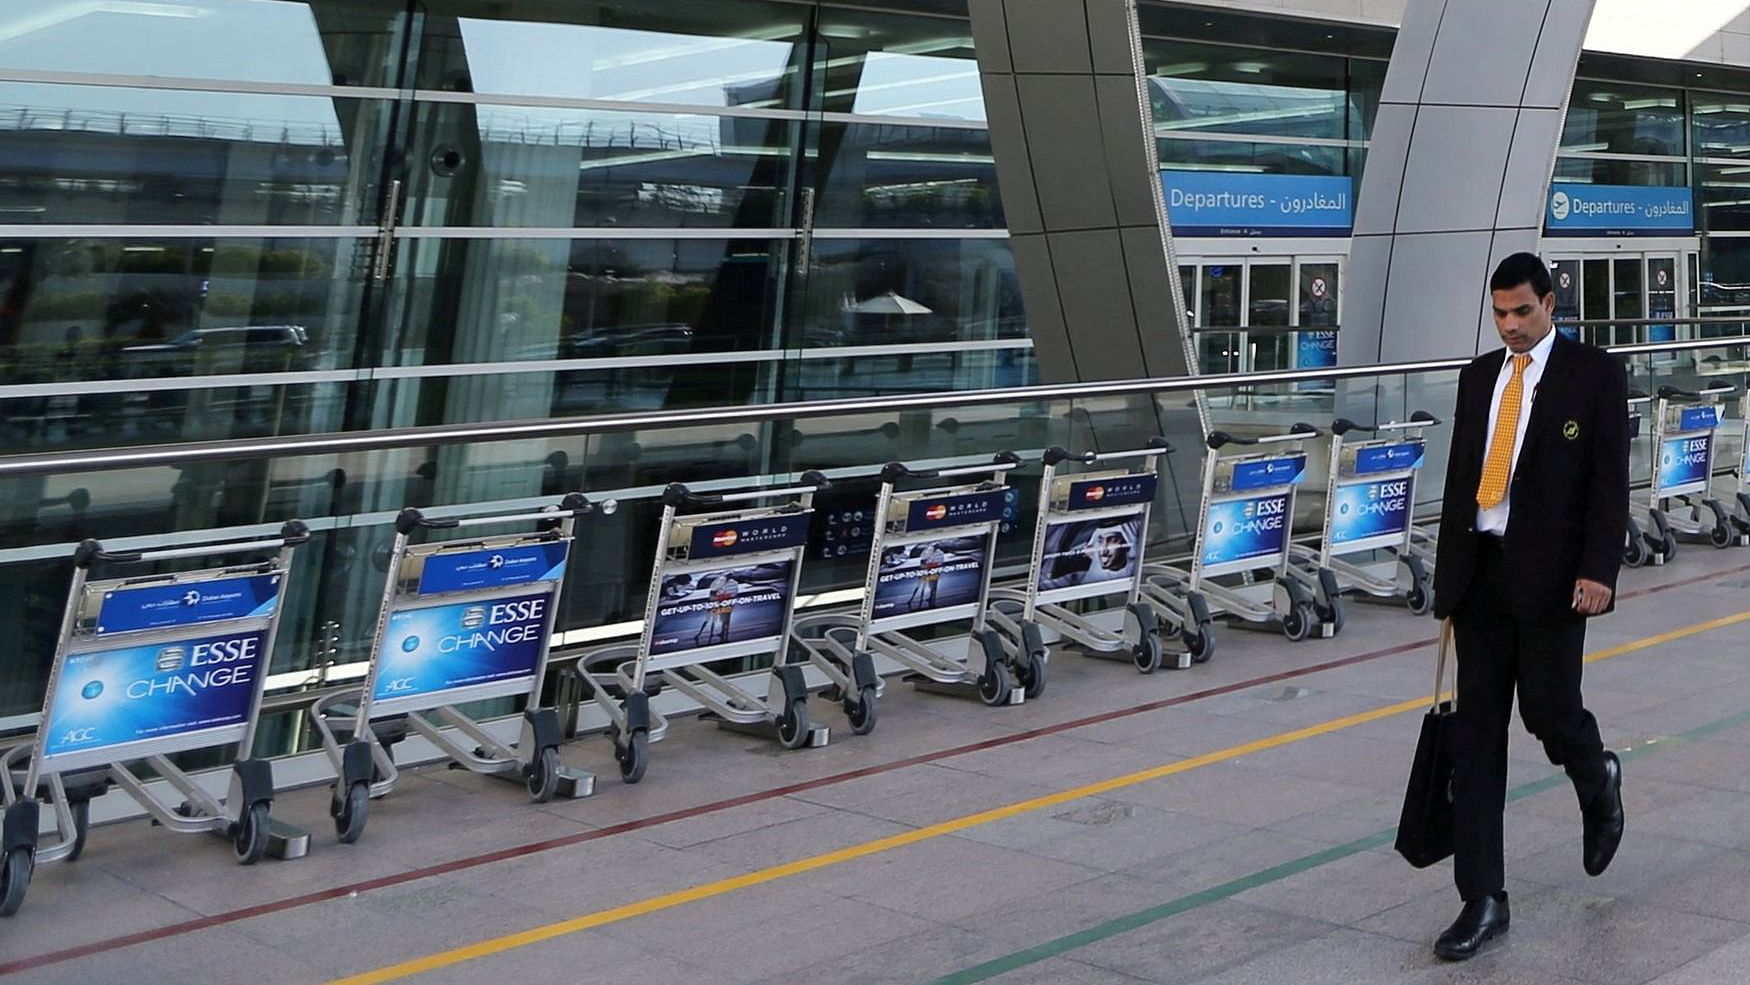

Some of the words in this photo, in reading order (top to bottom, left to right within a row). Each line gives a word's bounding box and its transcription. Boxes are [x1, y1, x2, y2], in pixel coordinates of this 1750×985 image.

[1171, 189, 1264, 211] Departures
[1280, 192, 1346, 213] المغادرون
[1573, 198, 1635, 216] Departures
[1645, 201, 1689, 217] المغادرون
[1690, 439, 1707, 452] ESSE
[1380, 482, 1407, 498] ESSE
[950, 501, 988, 511] WORLD
[1257, 498, 1286, 516] ESSE
[1357, 498, 1405, 516] CHANGE
[742, 526, 787, 537] WORLD
[1232, 516, 1283, 535] CHANGE
[490, 600, 545, 625] ESSE
[438, 624, 540, 653] CHANGE
[191, 638, 258, 667] ESSE
[126, 665, 253, 699] CHANGE
